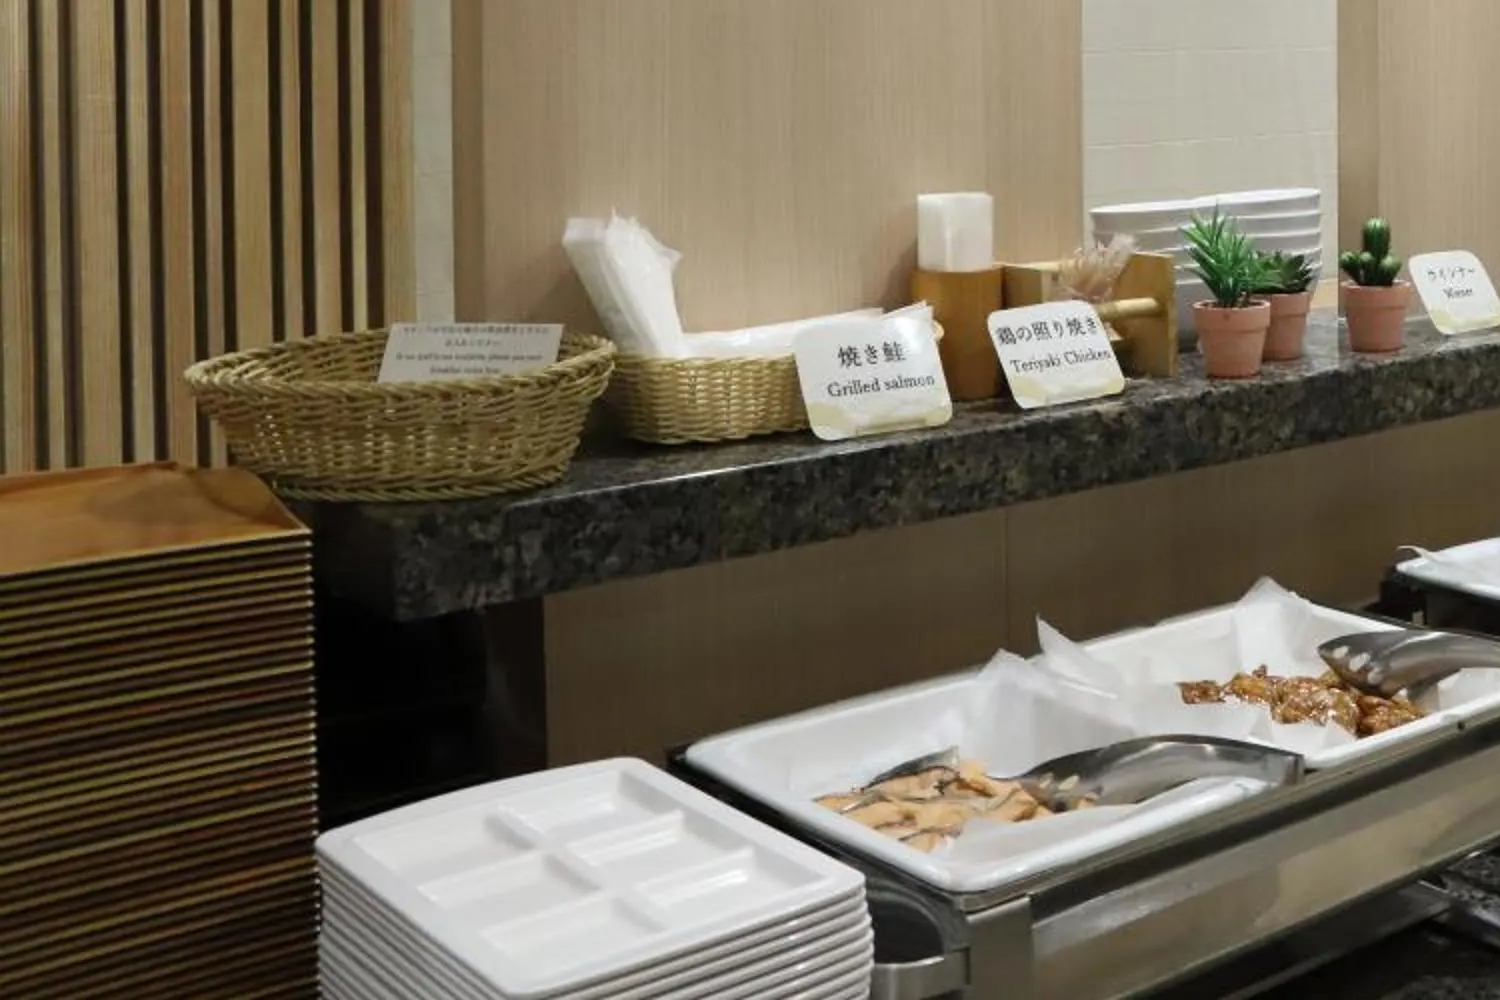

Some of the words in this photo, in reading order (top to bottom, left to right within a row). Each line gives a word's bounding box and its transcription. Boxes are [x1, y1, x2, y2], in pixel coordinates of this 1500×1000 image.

[996, 316, 1097, 346] 鶏の照り焼き
[837, 341, 907, 368] 焼き鮭
[1010, 357, 1061, 376] Teriyaki
[1064, 349, 1110, 367] Chicken
[827, 375, 880, 398] Grilled
[884, 373, 935, 391] salmon
